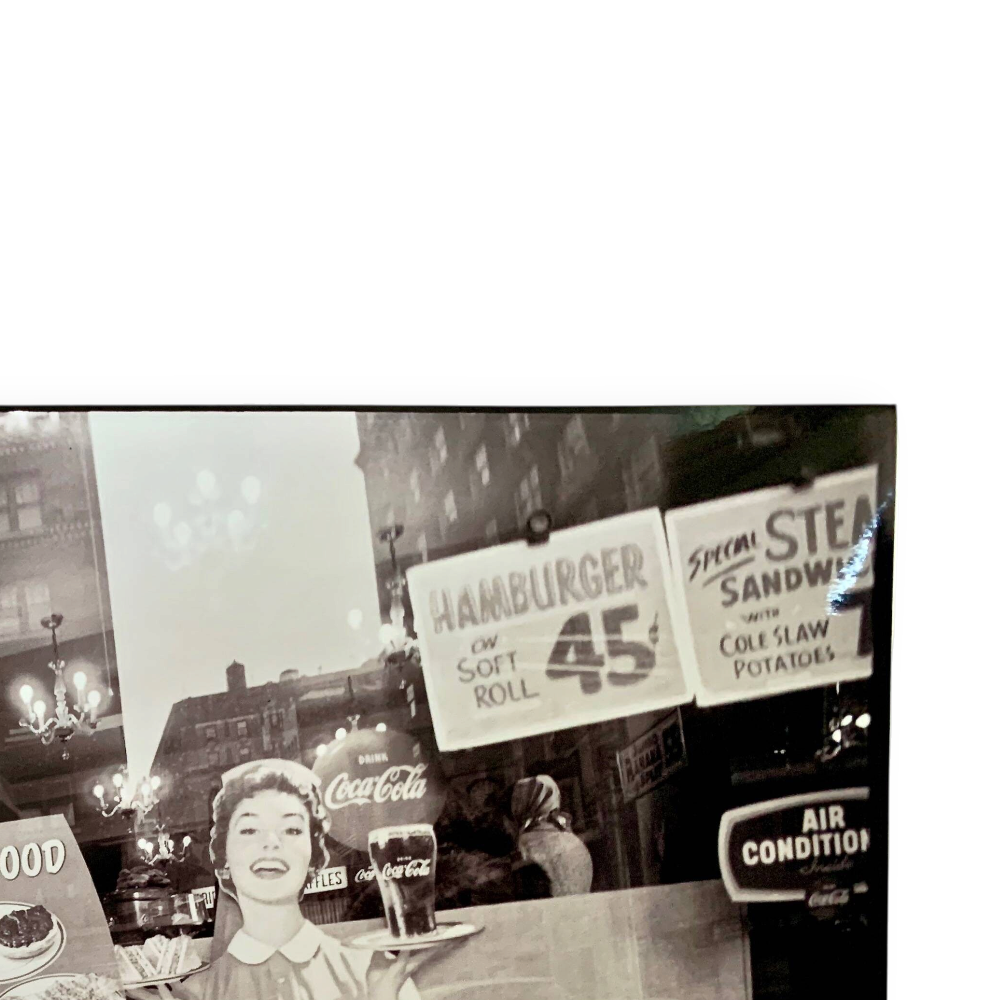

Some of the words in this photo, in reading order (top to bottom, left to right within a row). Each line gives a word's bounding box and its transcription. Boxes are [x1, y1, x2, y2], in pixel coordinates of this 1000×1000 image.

[429, 543, 649, 634] HAMBURGER
[471, 635, 498, 655] ON
[719, 630, 769, 658] COLE
[773, 618, 830, 647] SLAW
[457, 651, 517, 684] SOFT
[734, 645, 835, 680] POTATOES
[474, 680, 539, 709] ROLL
[358, 752, 389, 765] DRINK
[324, 763, 428, 809] Coca-Cola
[802, 804, 846, 833] AIR
[382, 859, 431, 881] Coca-Cola
